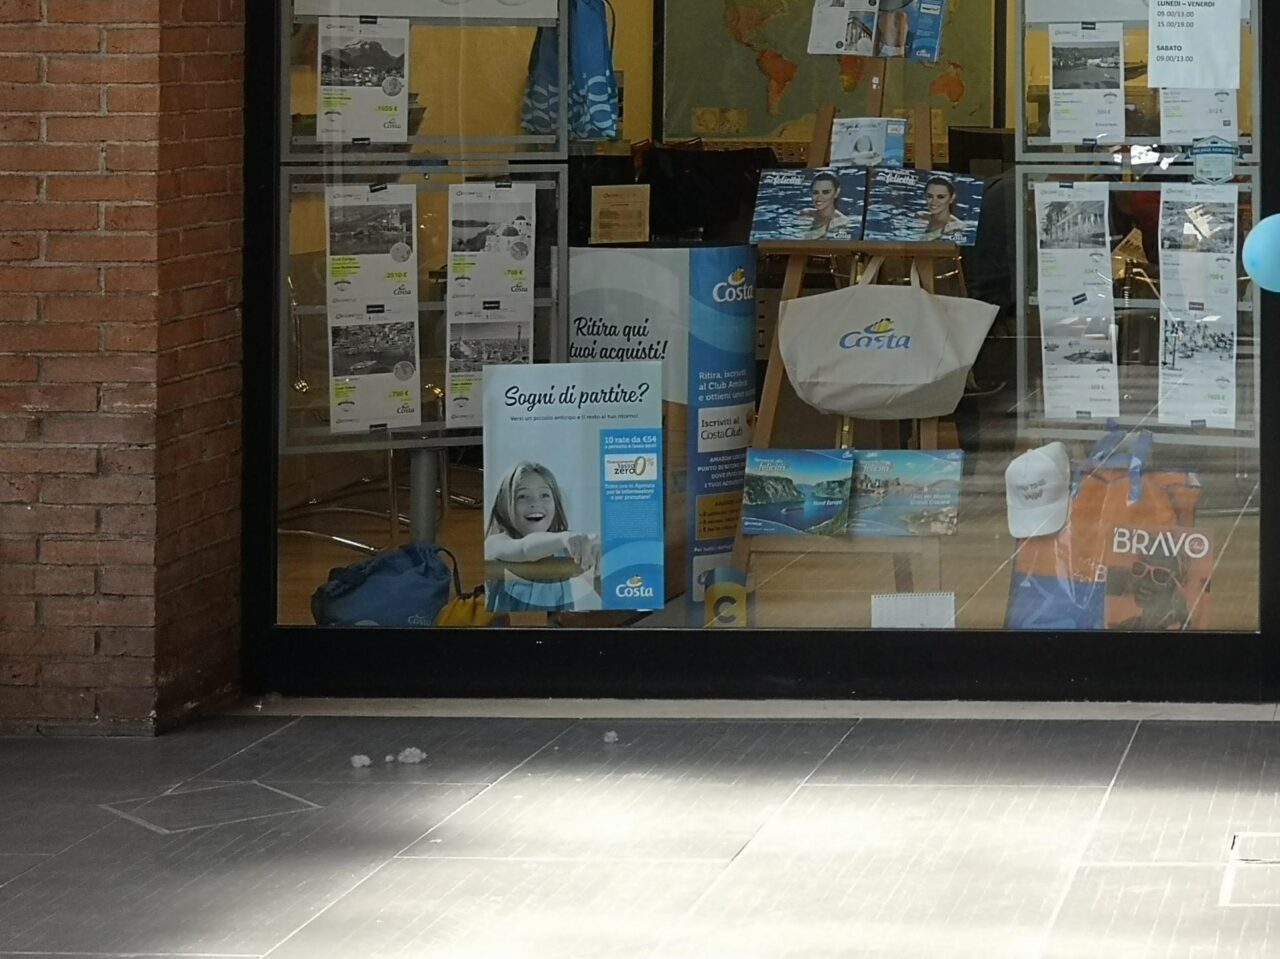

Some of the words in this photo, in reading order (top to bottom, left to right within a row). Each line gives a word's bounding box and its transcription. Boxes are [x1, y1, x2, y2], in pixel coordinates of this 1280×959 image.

[712, 281, 754, 303] Costa
[573, 317, 621, 338] Ritira
[623, 318, 650, 342] qui
[839, 331, 911, 350] Costa
[569, 341, 597, 360] tuoi
[599, 340, 669, 362] acquisti!
[698, 383, 707, 391] al
[708, 381, 727, 391] Club
[504, 384, 556, 412] Sogni
[558, 384, 576, 404] di
[578, 382, 650, 409] partire?
[705, 392, 731, 401] ottieni
[701, 417, 732, 428] Iscriviti
[733, 416, 740, 425] al
[604, 436, 614, 444] 10
[615, 436, 630, 444] rate
[631, 435, 641, 443] da
[1112, 527, 1209, 558] BRAVO
[615, 581, 654, 598] Costa
